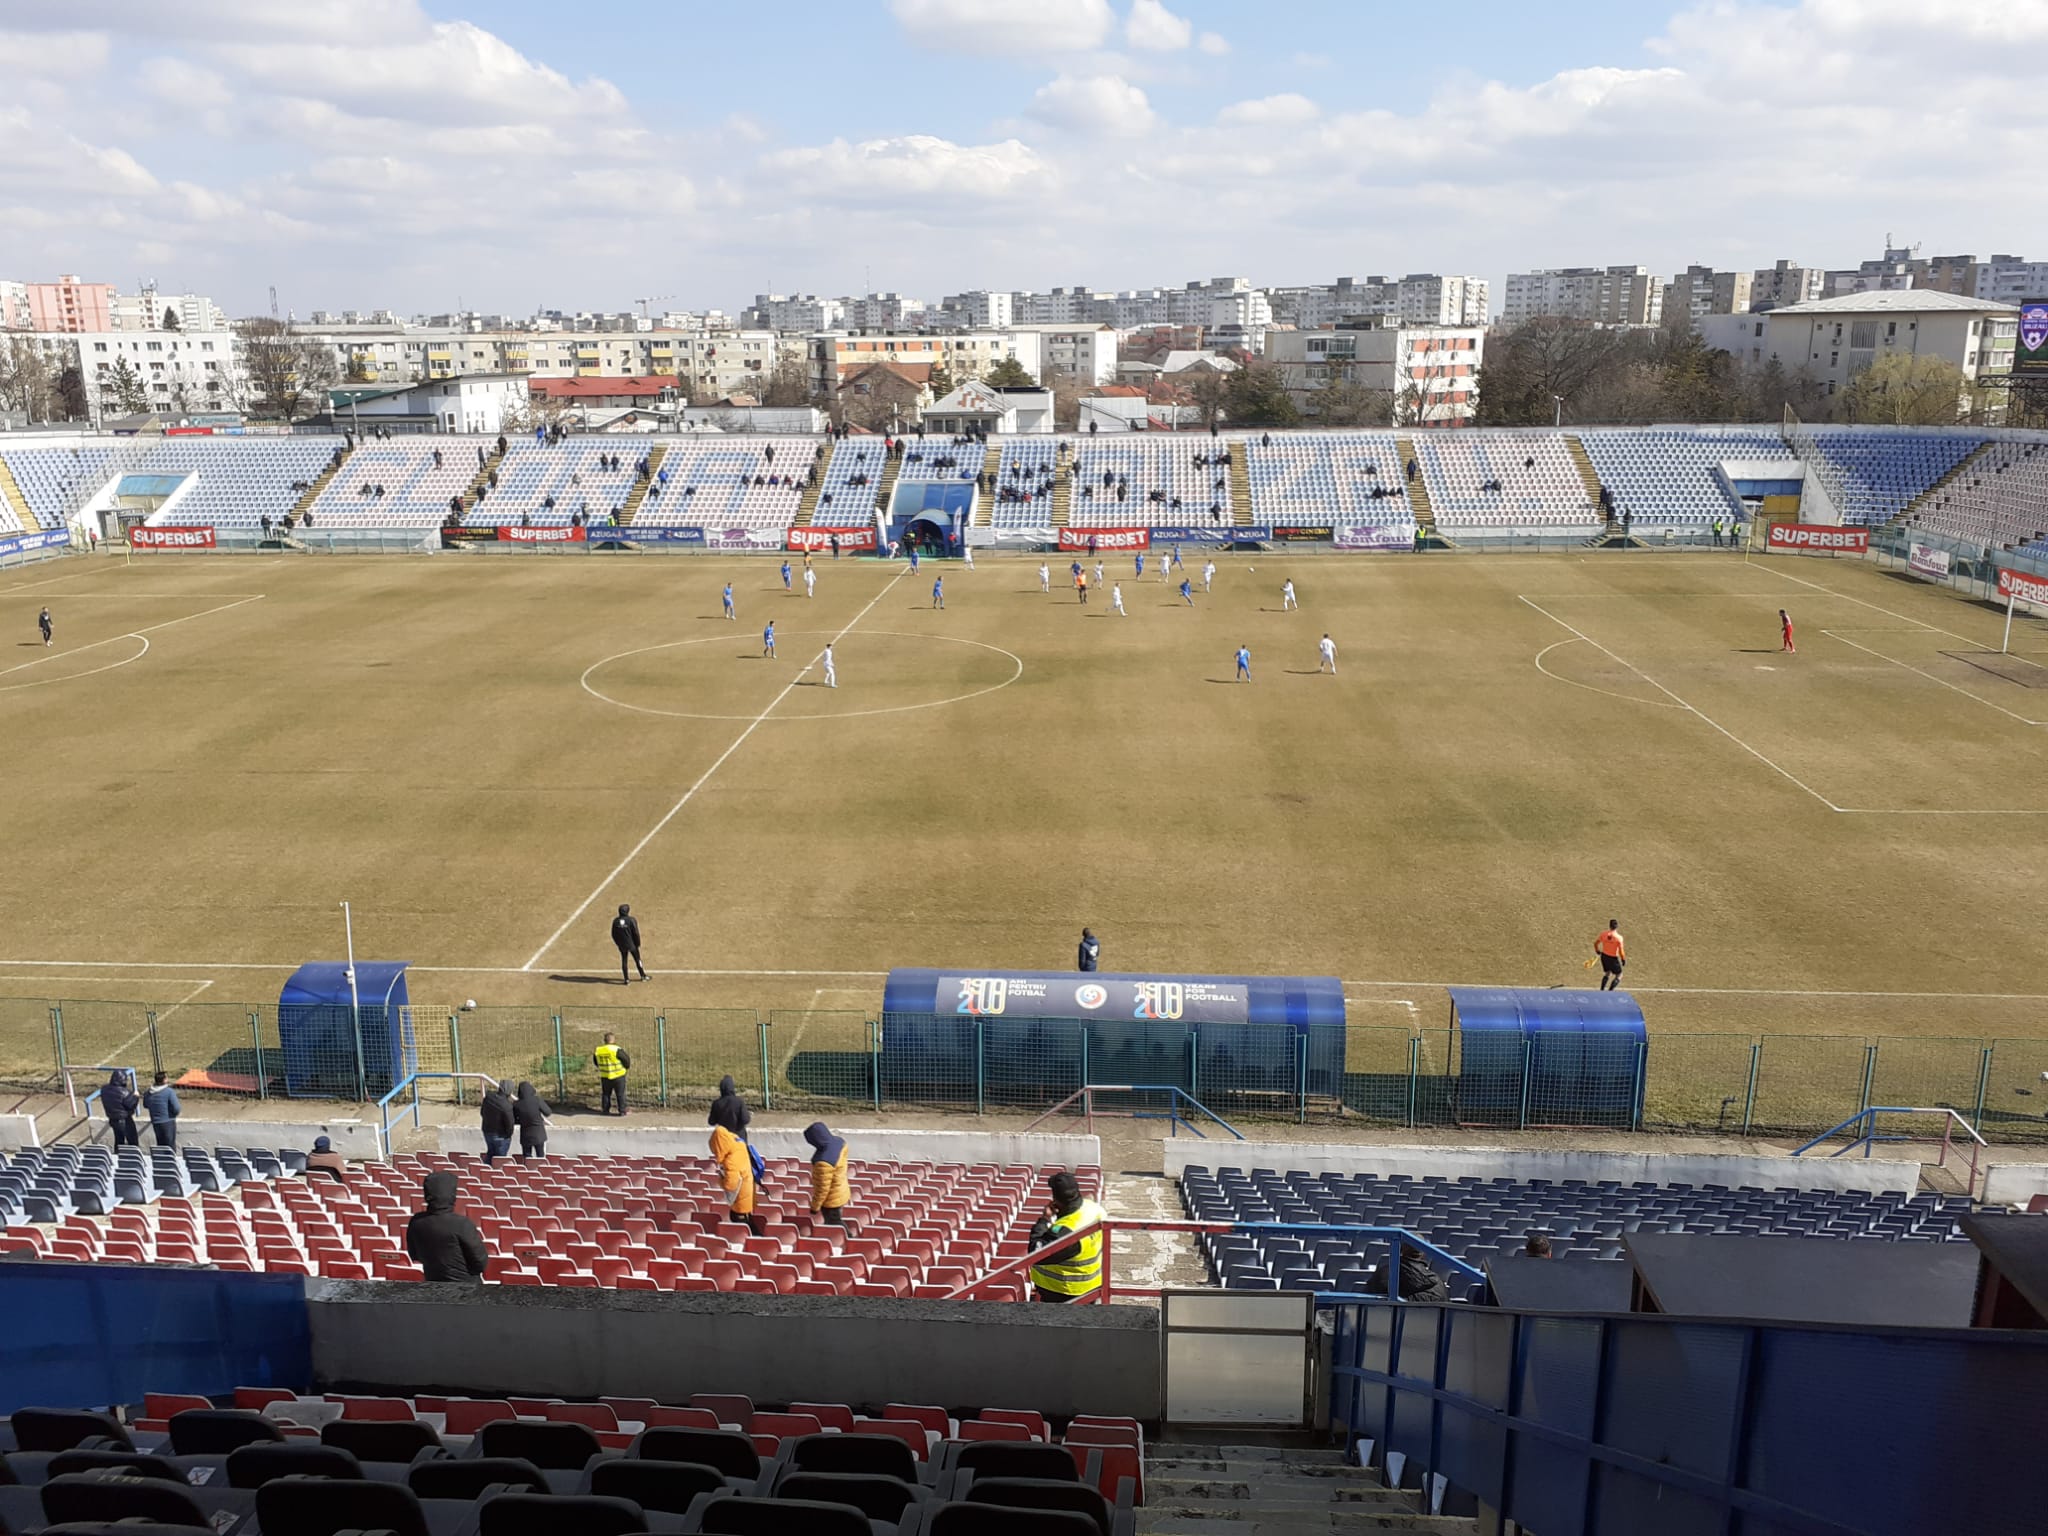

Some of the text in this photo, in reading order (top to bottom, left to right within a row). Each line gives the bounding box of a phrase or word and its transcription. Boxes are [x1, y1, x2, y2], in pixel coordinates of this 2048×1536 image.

[133, 529, 212, 545] SUPERBET
[510, 527, 574, 541] SUPERBET
[1771, 526, 1868, 547] SUPERBET
[1911, 552, 1947, 571] Romfour
[1007, 989, 1047, 997] FOTBAL
[1185, 993, 1238, 1002] FOOTBALL
